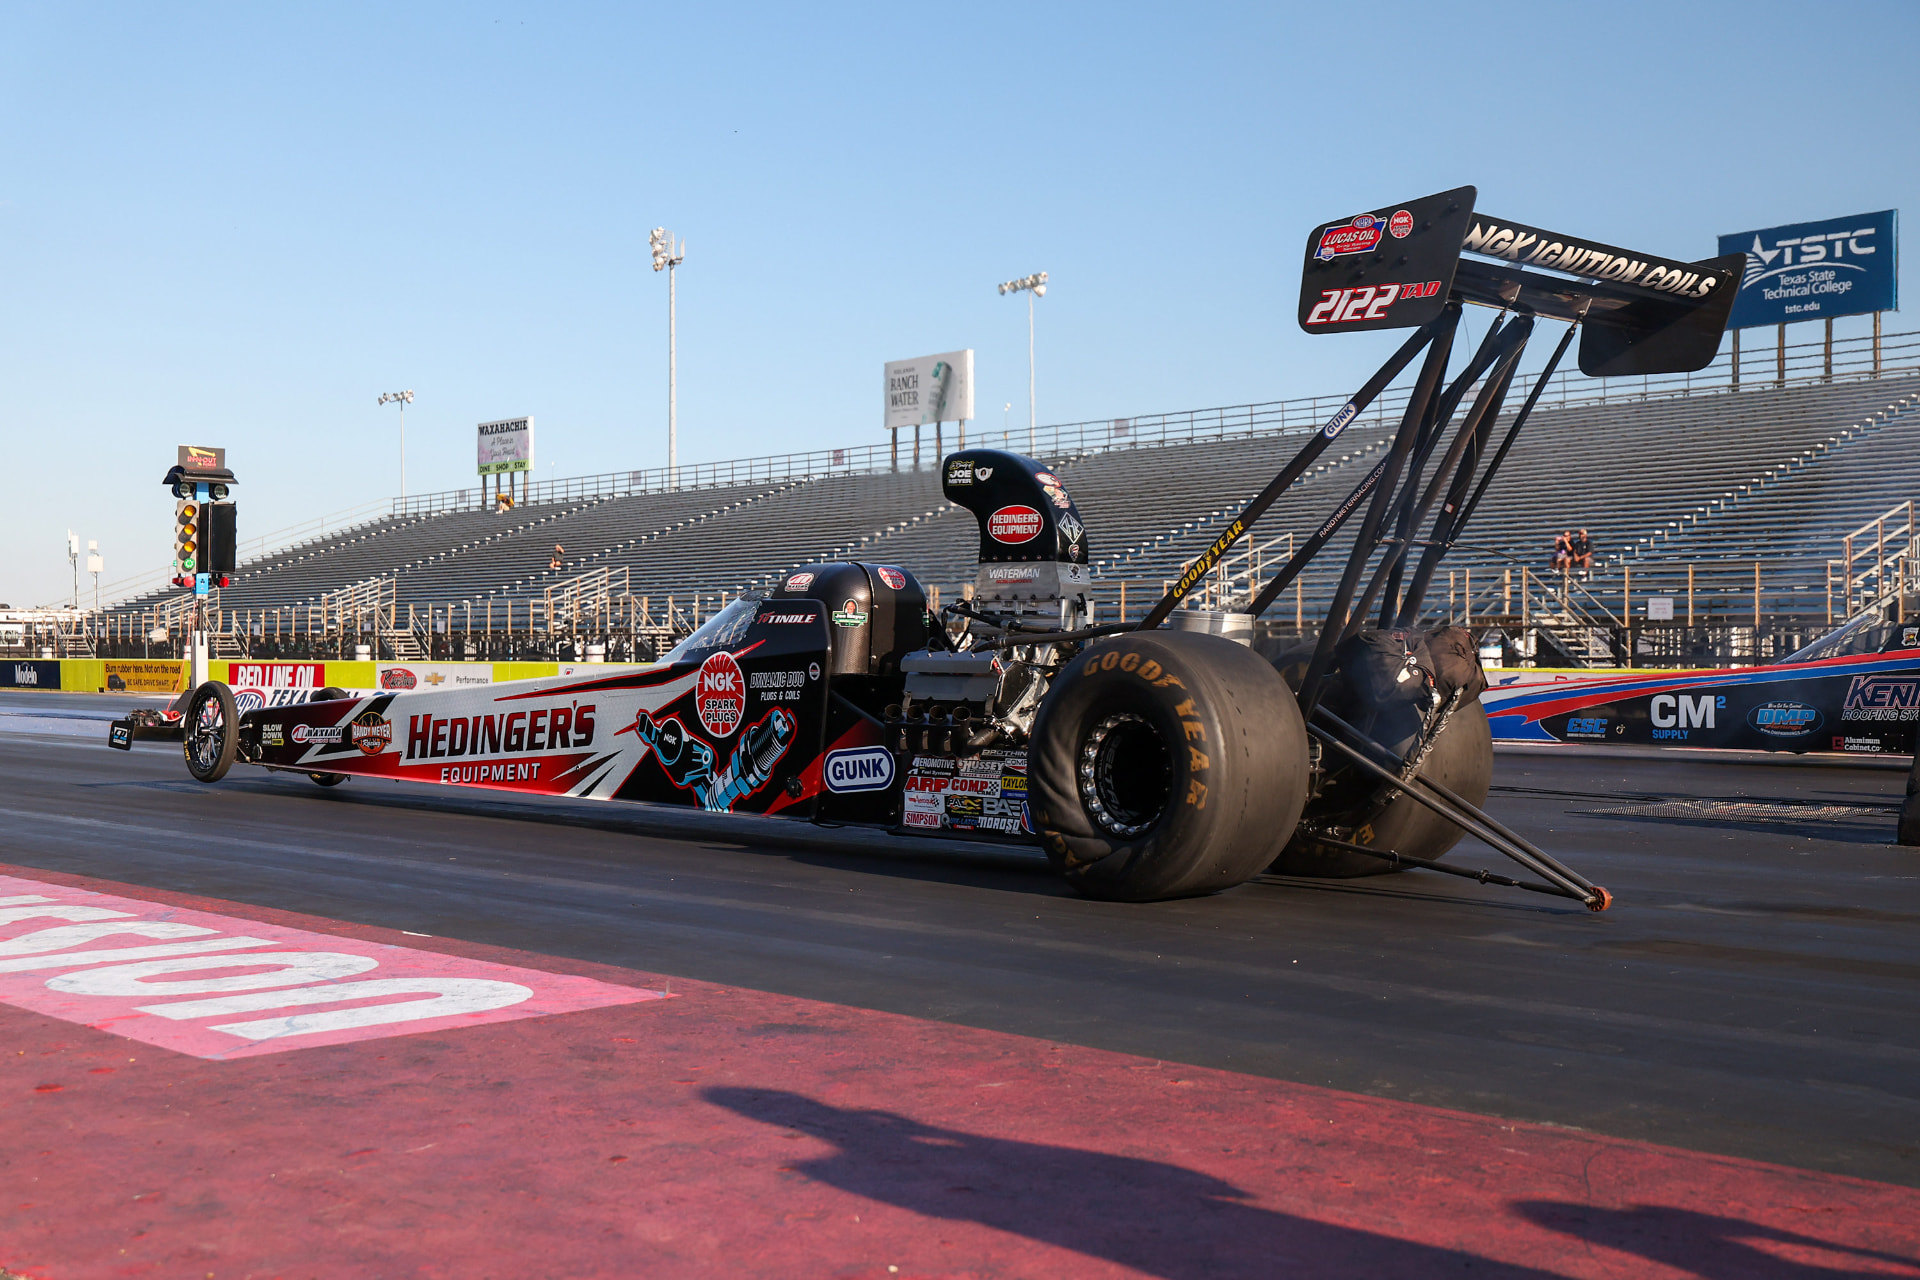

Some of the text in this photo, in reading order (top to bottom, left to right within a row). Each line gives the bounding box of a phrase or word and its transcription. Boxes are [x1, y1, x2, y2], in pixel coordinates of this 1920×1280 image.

[1393, 216, 1409, 224] NGK
[1324, 229, 1376, 246] LUCAS OIL
[1775, 227, 1877, 266] TSTC
[1463, 222, 1717, 298] NGK IGNITION COILS
[1778, 269, 1836, 286] Texas State
[1762, 278, 1853, 301] Technical College
[1306, 281, 1442, 325] 2122 TAD
[1785, 301, 1821, 314] tstc.edu
[890, 374, 919, 391] RANCH
[890, 391, 919, 408] WATER
[1327, 405, 1354, 436] GUNK
[478, 420, 528, 436] WAXAHACHIE
[514, 460, 527, 470] STAY
[949, 469, 972, 479] JOE
[1318, 462, 1386, 539] RANDYMEYERRACING.COM
[992, 513, 1040, 524] HEDINGER'S
[992, 524, 1039, 535] EQUIPMENT
[1172, 519, 1245, 599] GOODYEAR
[989, 568, 1041, 579] WATERMAN
[768, 613, 817, 624] TINDLE
[160, 664, 169, 674] the
[169, 664, 181, 674] road
[456, 676, 489, 685] Performance
[704, 672, 736, 692] NGK
[750, 671, 805, 688] DYNAMIC DUO
[761, 690, 801, 701] PLUGS & COILS
[705, 699, 736, 710] SPARK
[705, 711, 736, 723] PLUGS
[1757, 709, 1816, 725] DMP
[1841, 709, 1919, 721] ROOFING SY
[371, 724, 391, 738] MEYER
[406, 700, 596, 760] HEDINGER'S
[1083, 651, 1211, 811] GOODYEAR
[1567, 718, 1608, 734] ESC
[262, 731, 283, 739] DOWN
[663, 733, 678, 745] NGK
[1652, 729, 1689, 740] SUPPLY
[1844, 736, 1881, 744] Aluminum
[833, 757, 887, 781] GUNK
[912, 757, 956, 769] AEROMOTIVE
[960, 760, 1004, 772] HUSSEY
[440, 762, 541, 783] EQUIPMENT
[904, 777, 949, 792] ARP
[951, 779, 989, 792] COMP
